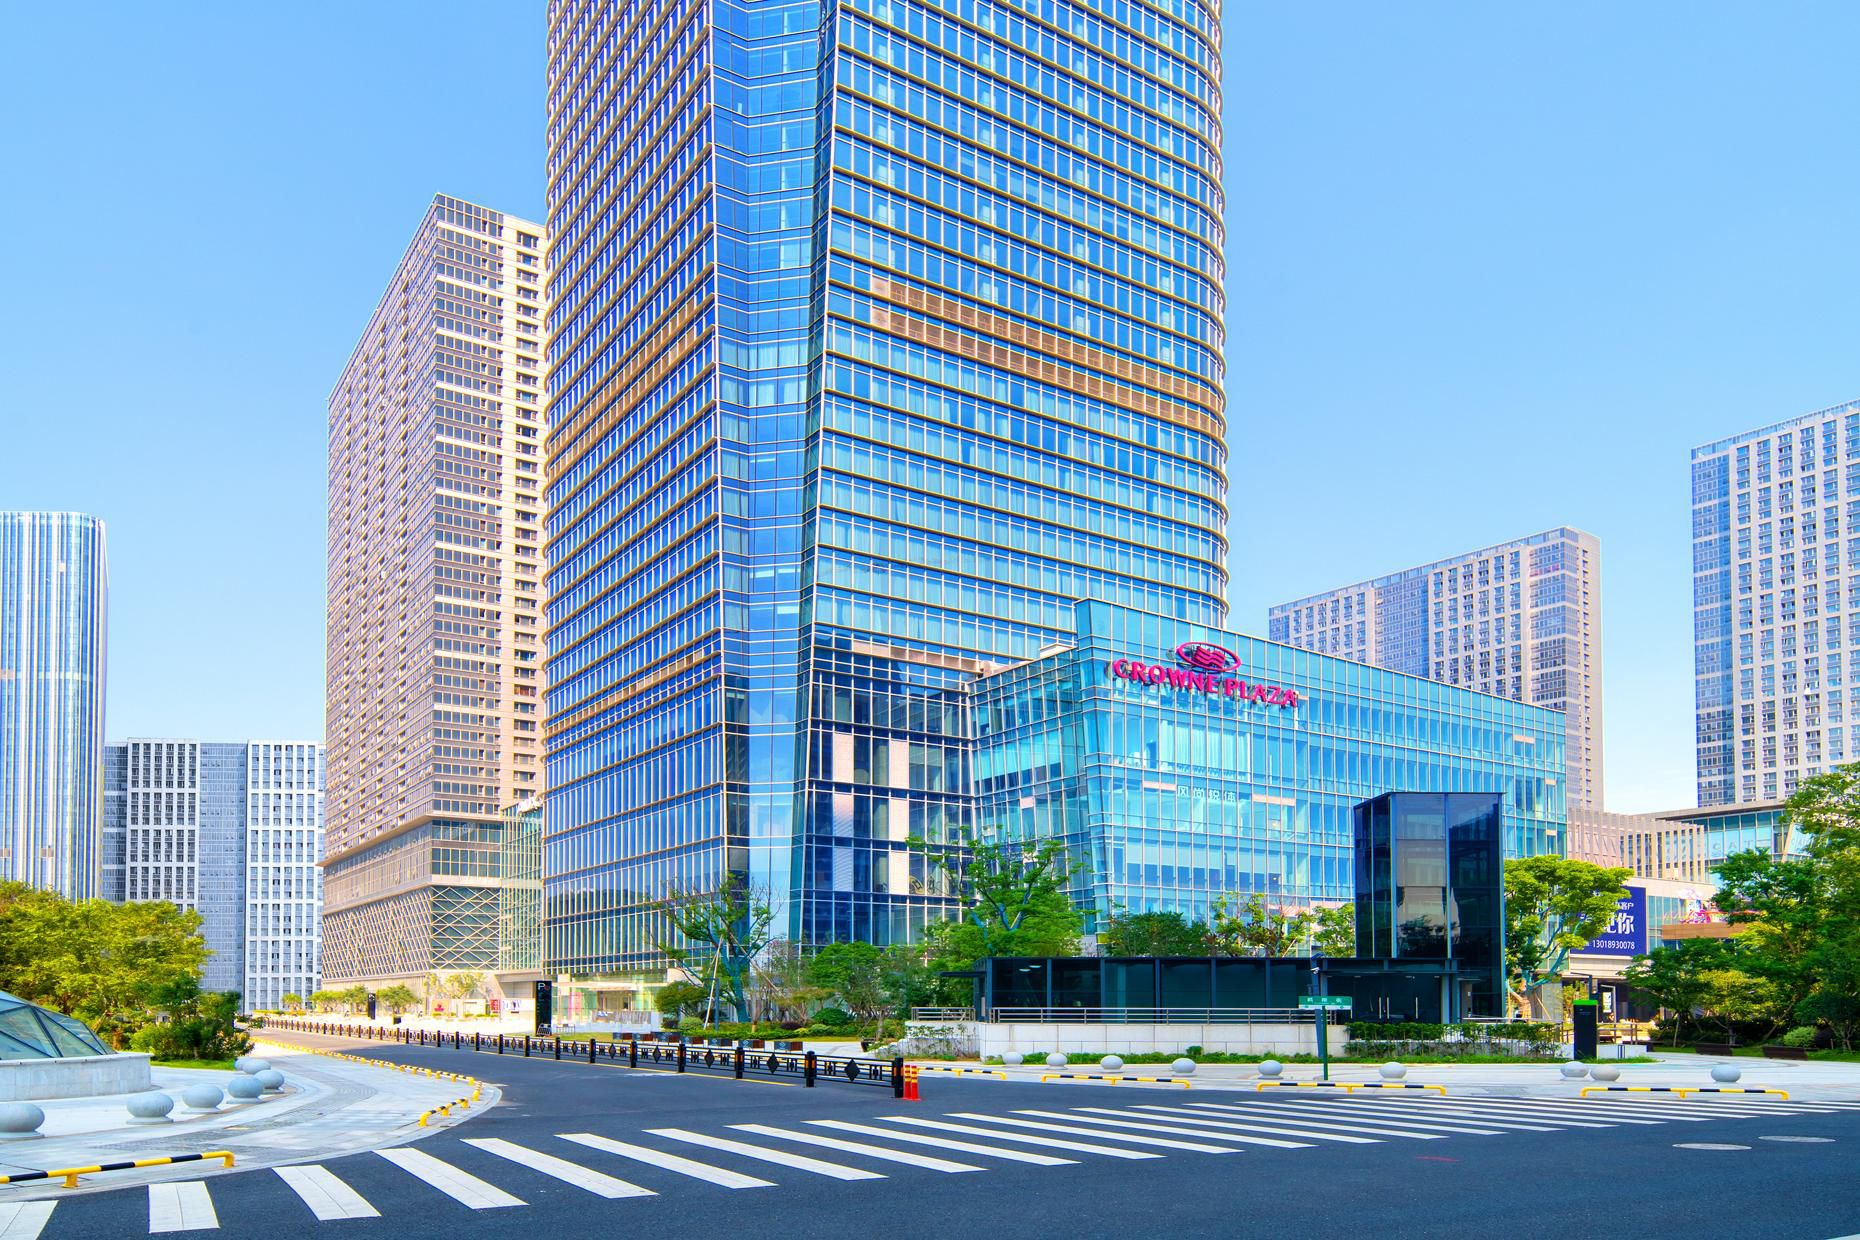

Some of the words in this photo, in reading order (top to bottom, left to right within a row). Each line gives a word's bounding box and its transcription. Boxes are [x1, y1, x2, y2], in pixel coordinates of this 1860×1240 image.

[1113, 658, 1219, 694] CROWNE
[1225, 677, 1297, 707] PLAZA
[1592, 939, 1636, 950] 13018930078
